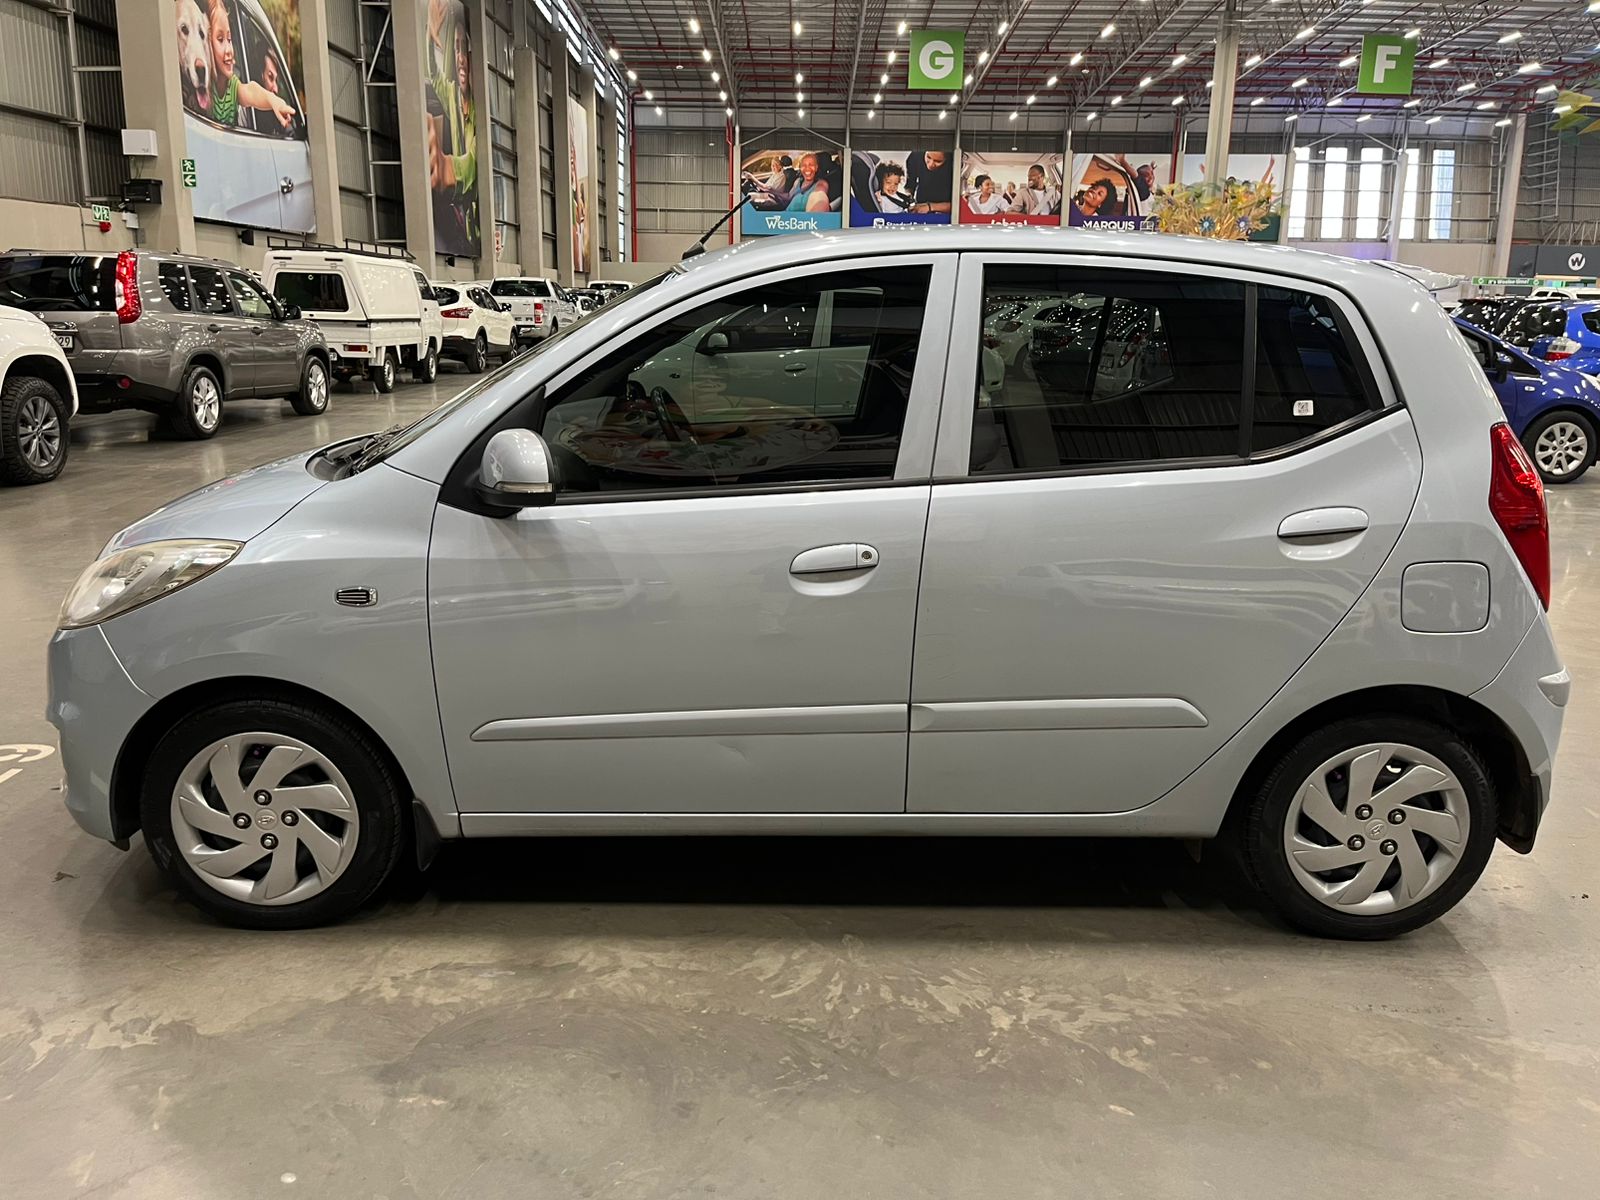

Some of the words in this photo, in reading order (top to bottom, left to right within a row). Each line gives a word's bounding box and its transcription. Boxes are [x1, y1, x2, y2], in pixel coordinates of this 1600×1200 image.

[919, 40, 954, 80] G
[1373, 45, 1402, 84] F
[765, 215, 818, 230] WesBank
[1083, 220, 1135, 230] MARQUIS
